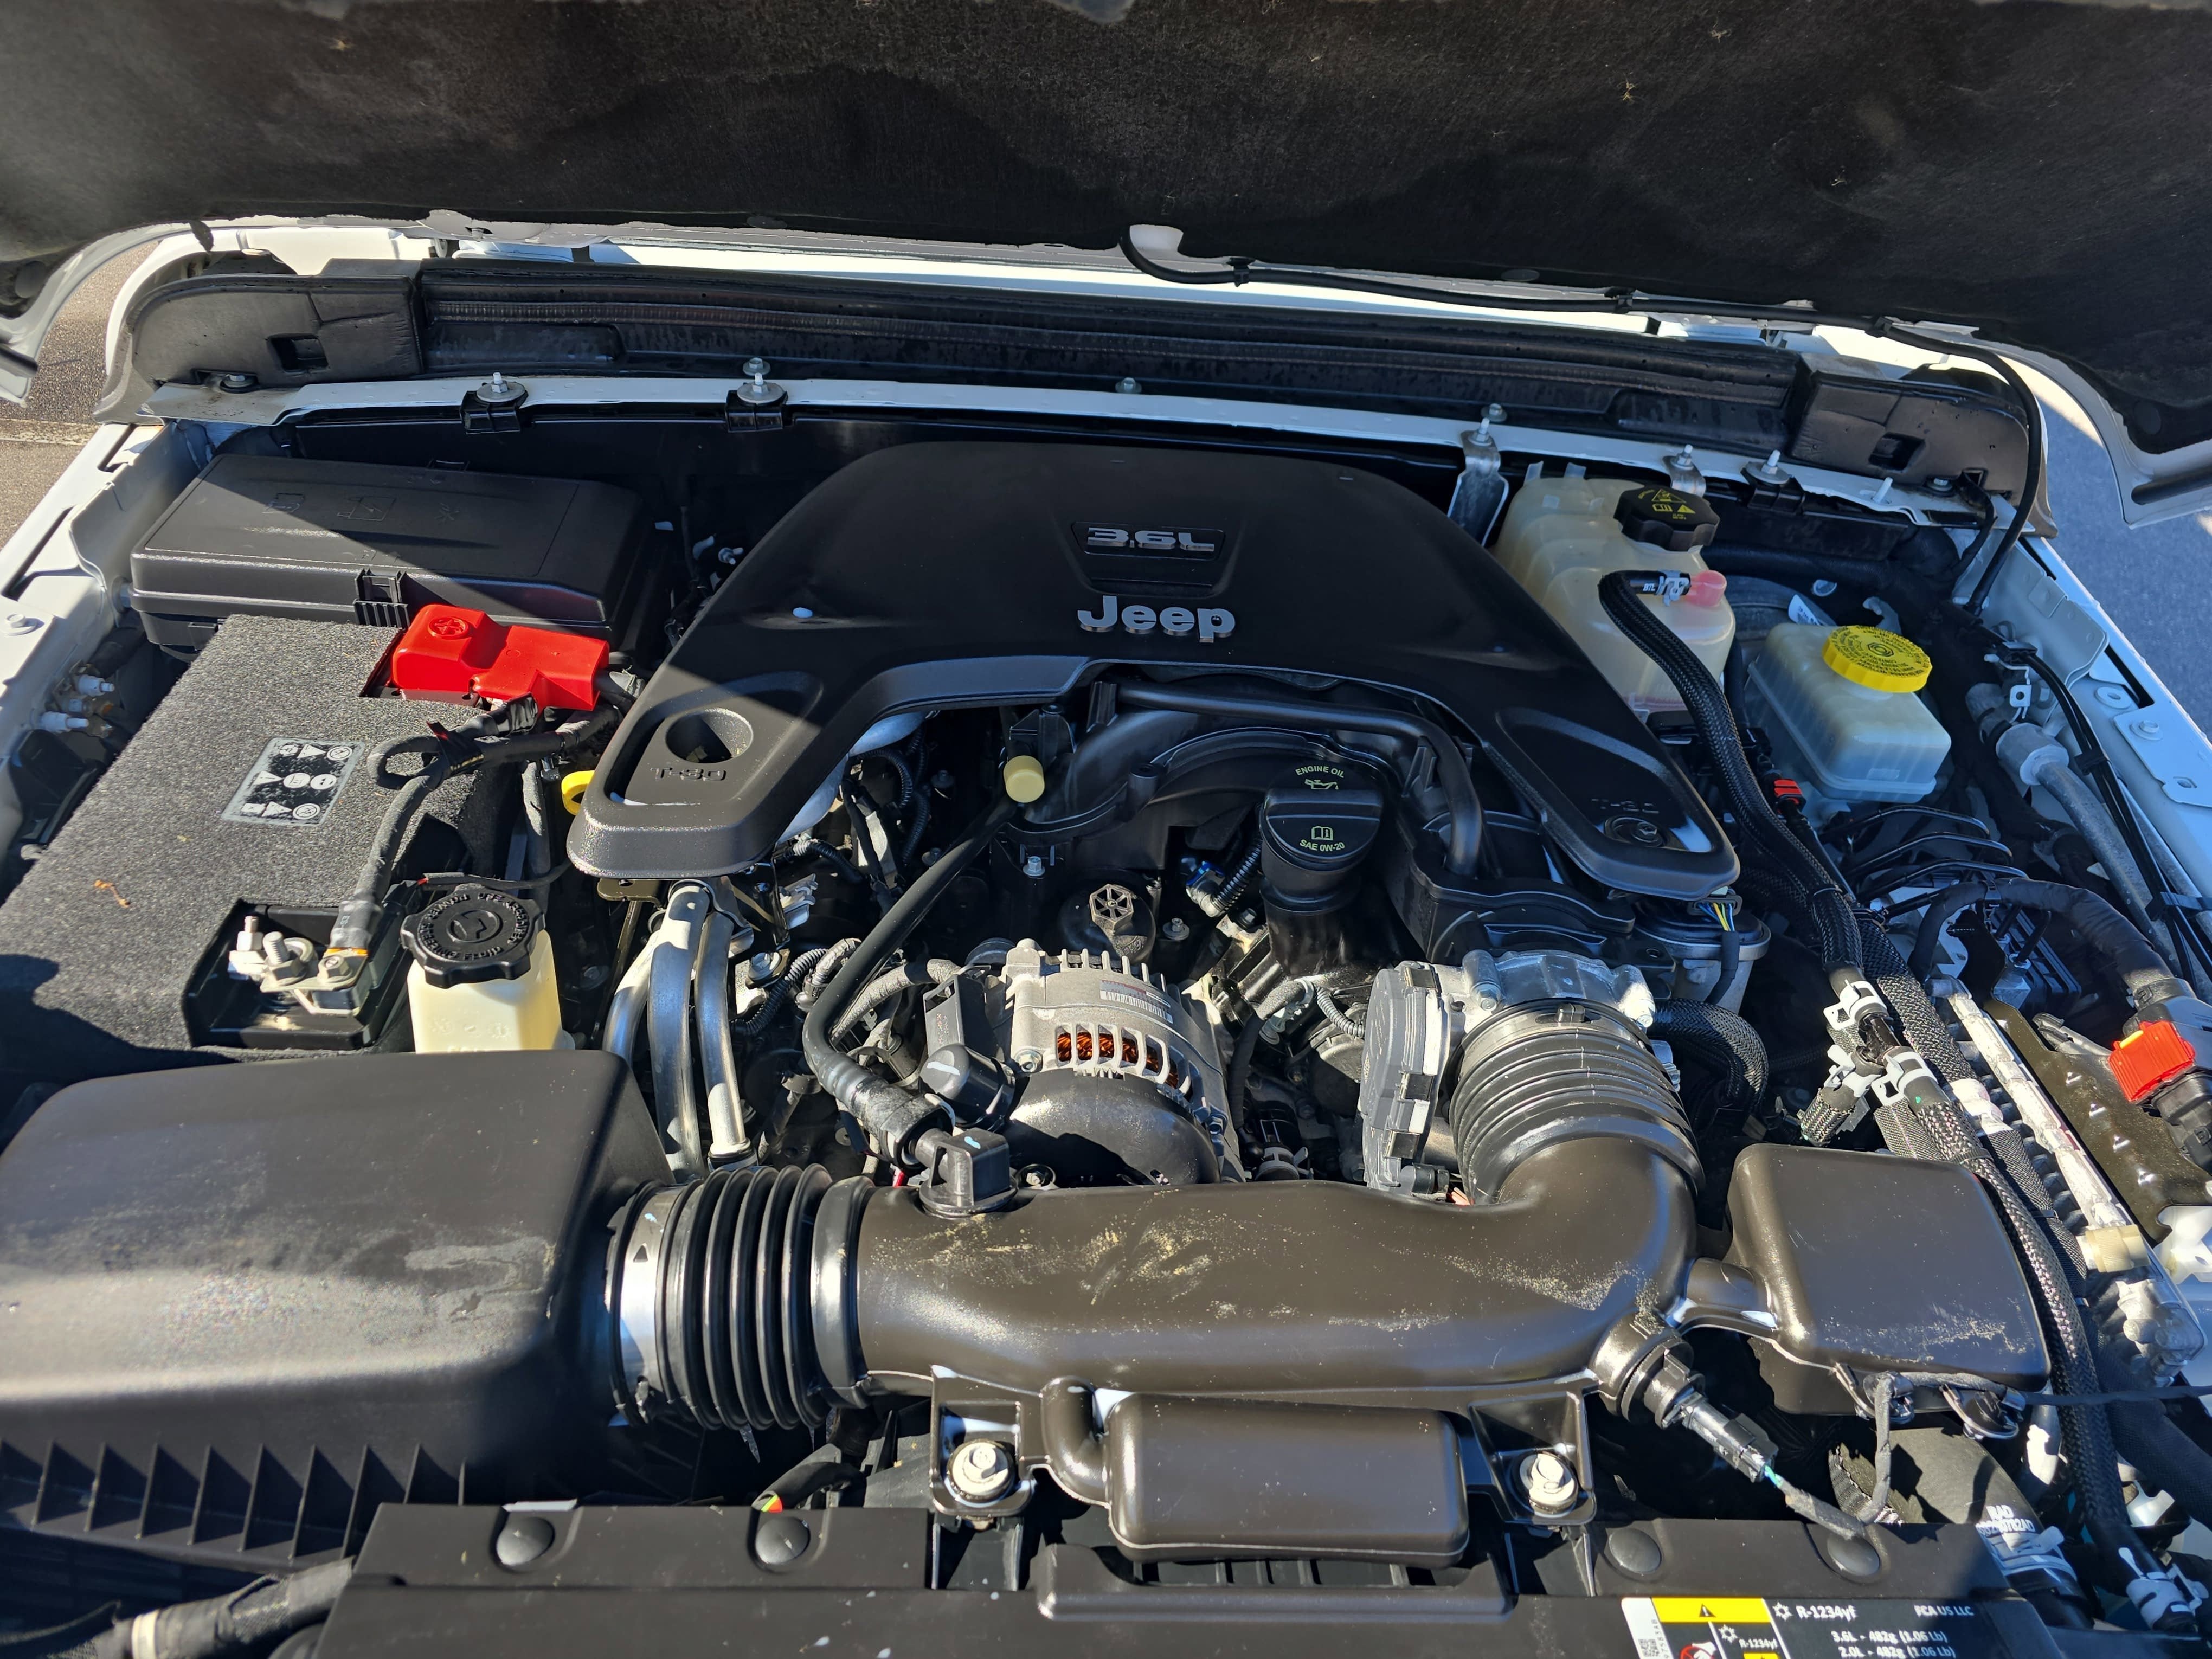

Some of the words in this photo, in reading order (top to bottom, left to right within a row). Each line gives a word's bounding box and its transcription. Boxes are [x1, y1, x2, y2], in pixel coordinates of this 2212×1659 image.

[1086, 526, 1215, 552] 3.6L
[1077, 595, 1236, 643] Jeep
[1295, 766, 1329, 776] ENGINE
[1331, 767, 1345, 778] OIL
[1300, 839, 1317, 851] SAE
[1319, 841, 1345, 851] 0W-20
[425, 893, 471, 921] POWER
[1796, 1605, 1857, 1622] R-1234yf
[1914, 1605, 1937, 1618] FCA
[1937, 1606, 1953, 1616] US
[1955, 1607, 1974, 1617] LLC
[1830, 1631, 1857, 1643] 3.6L
[1930, 1632, 1949, 1643] Lb)
[1739, 1638, 1779, 1649] R-1234yf
[1838, 1646, 1864, 1658] 2.0L
